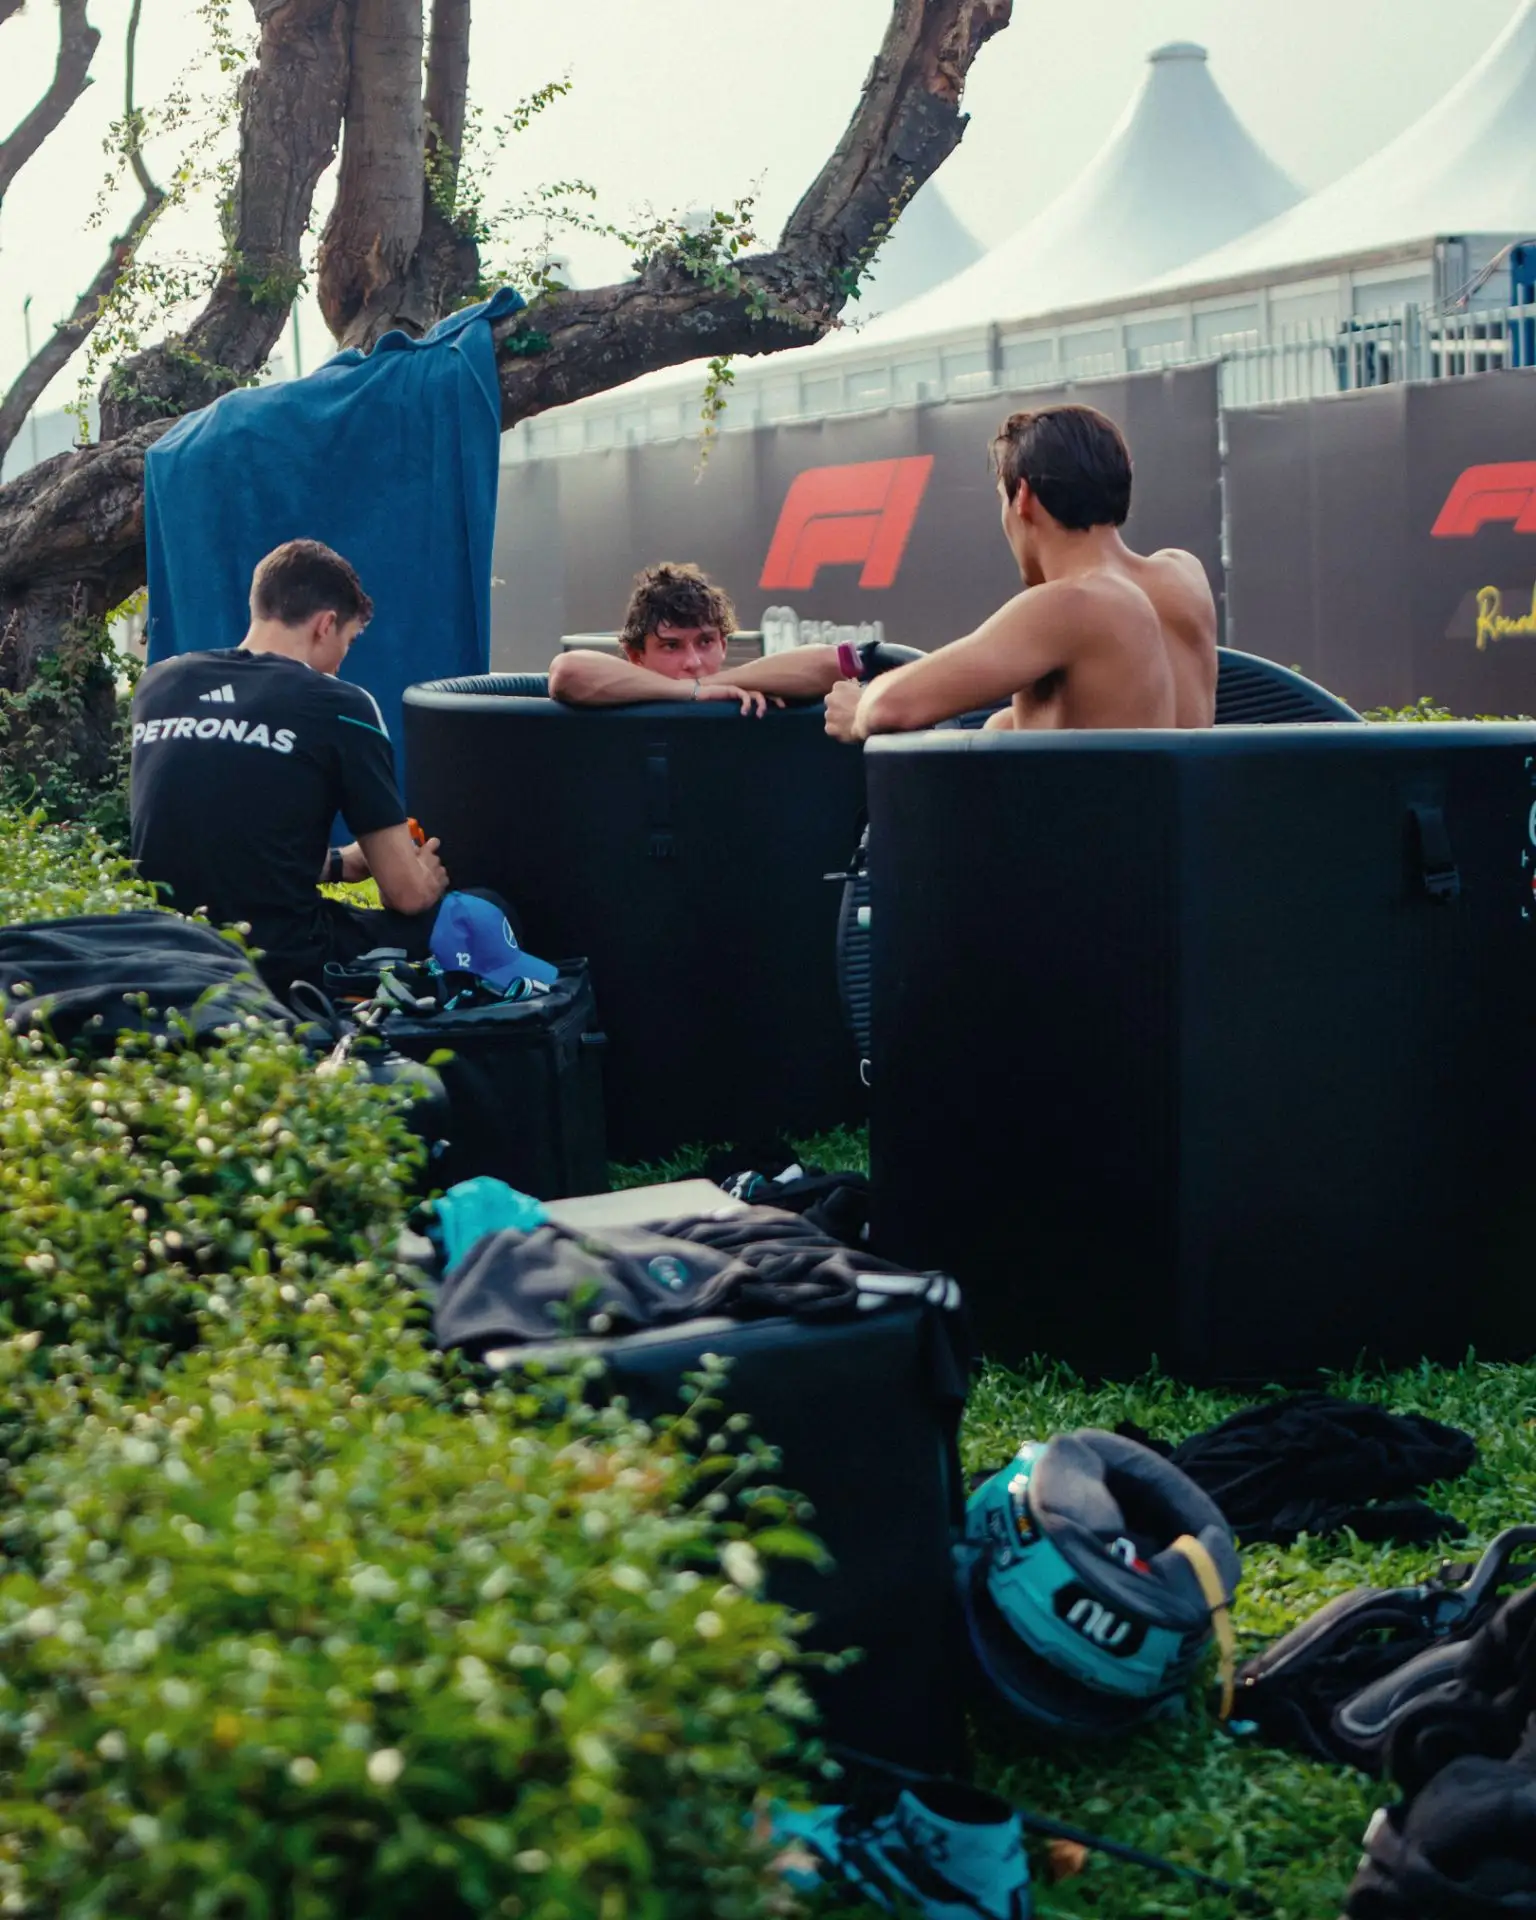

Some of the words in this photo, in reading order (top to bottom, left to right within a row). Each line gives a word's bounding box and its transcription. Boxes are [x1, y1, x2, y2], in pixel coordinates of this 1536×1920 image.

[758, 454, 935, 590] F1
[132, 717, 298, 754] PETRONAS
[455, 952, 472, 968] 12
